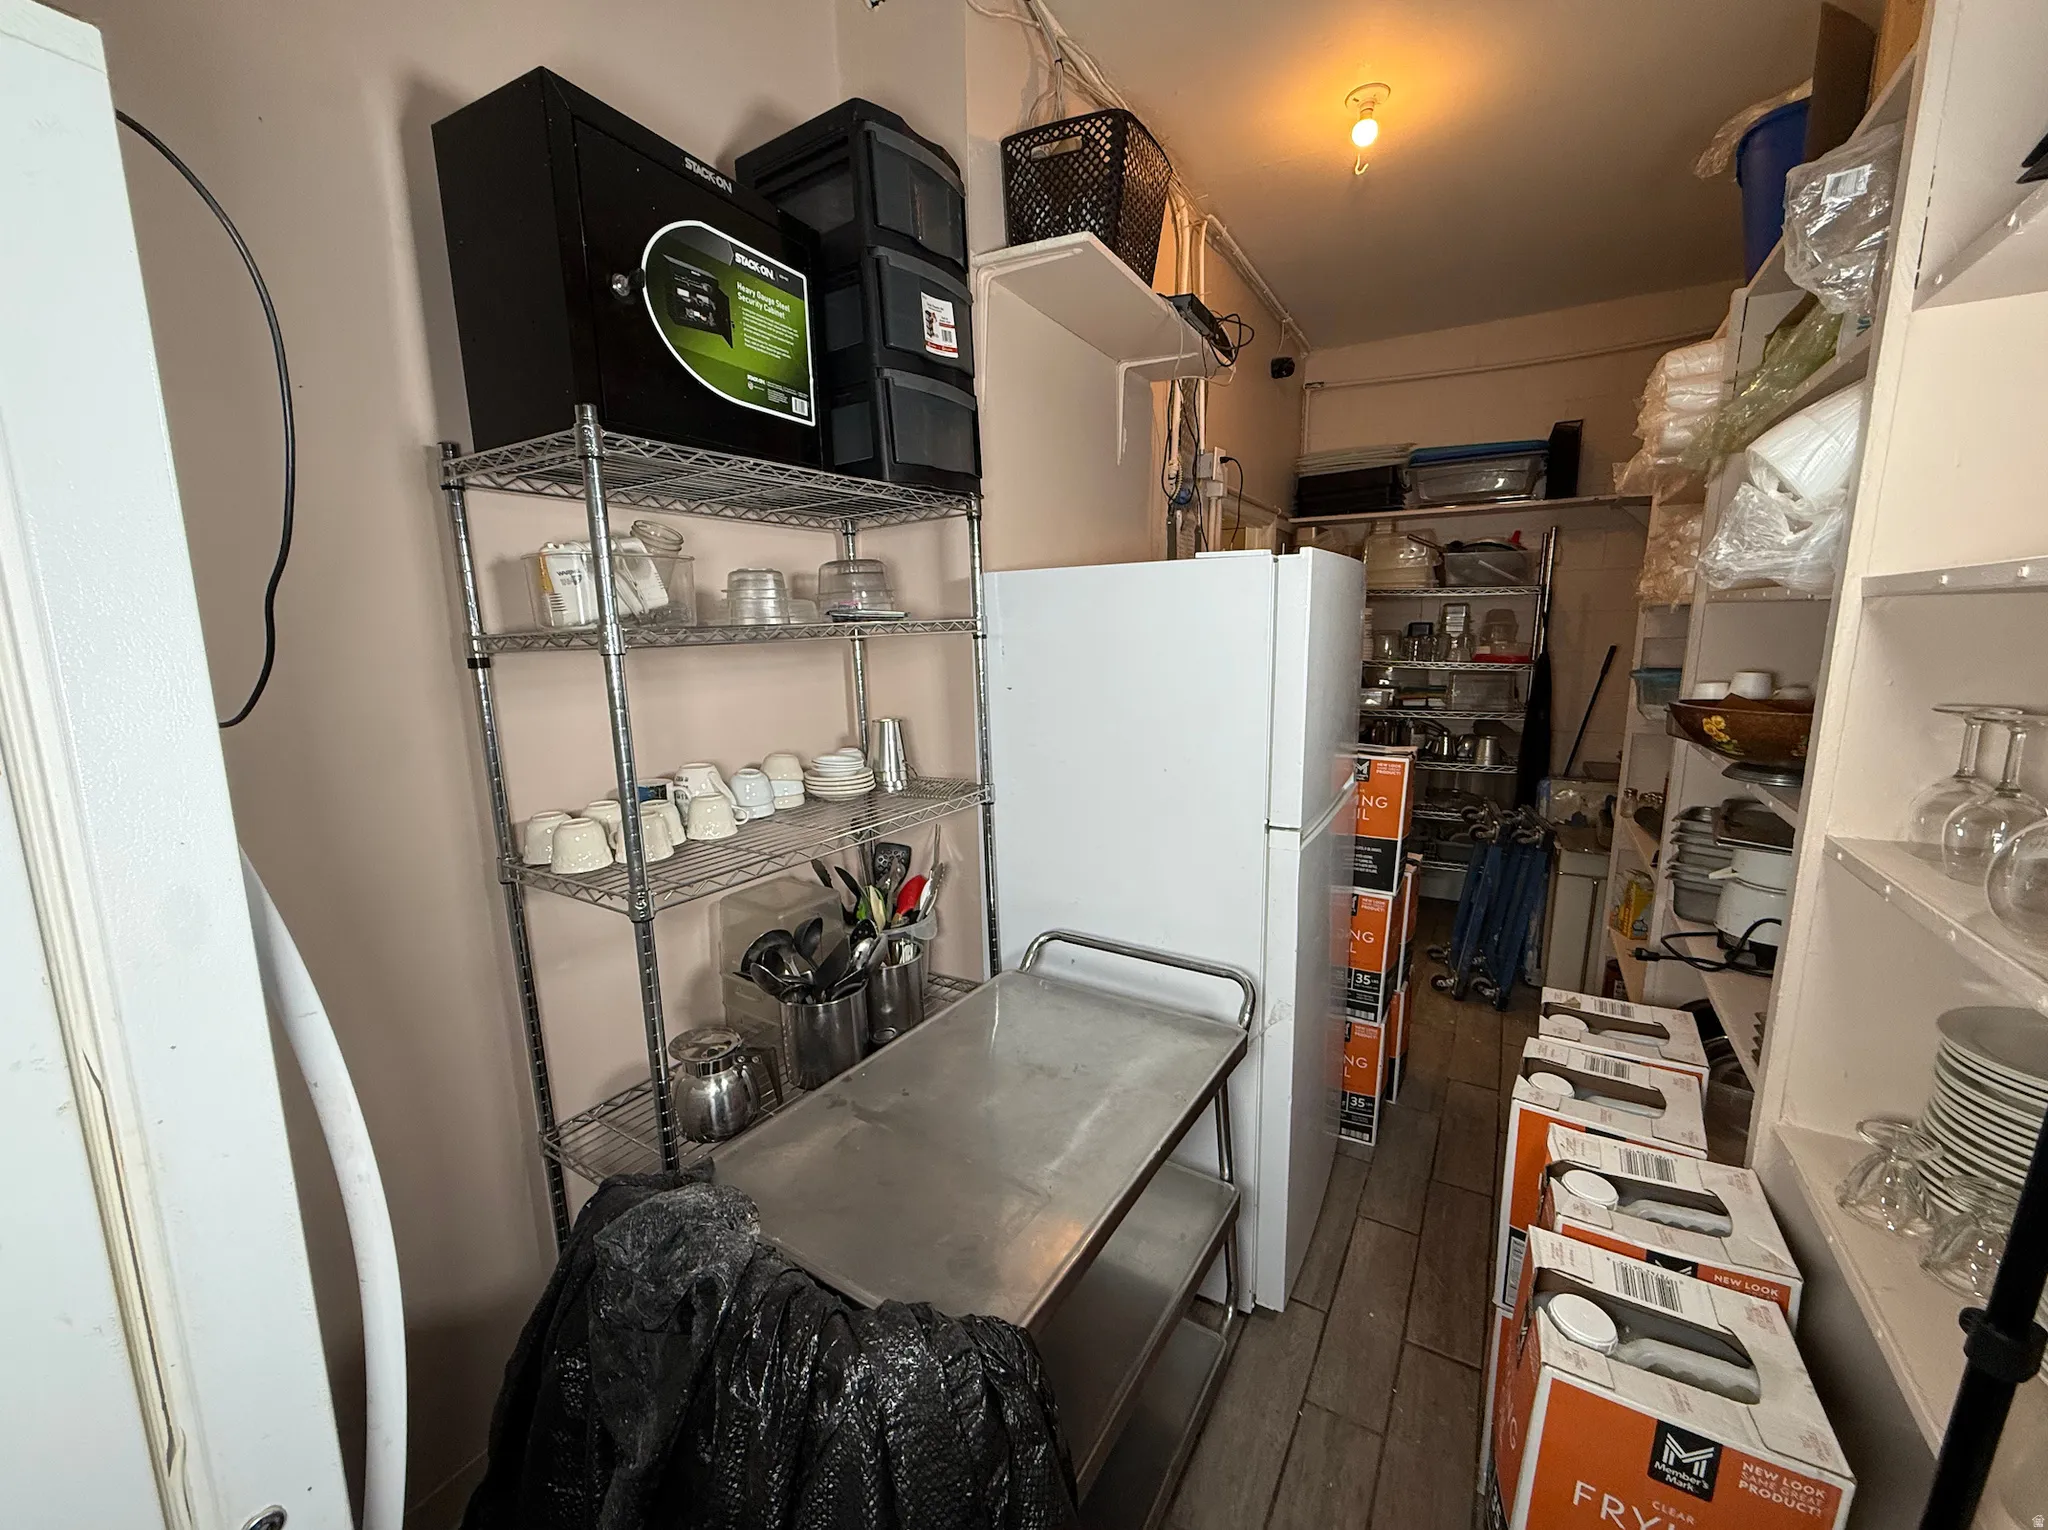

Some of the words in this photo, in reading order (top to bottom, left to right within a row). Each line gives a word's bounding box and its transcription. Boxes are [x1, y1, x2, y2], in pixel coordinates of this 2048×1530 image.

[684, 156, 733, 194] STACK-ON
[734, 252, 775, 281] STACK-ON
[736, 281, 756, 298] Heavy
[756, 290, 775, 306] Gauge
[775, 299, 790, 312] Steel
[737, 291, 763, 310] Security
[763, 303, 785, 319] Cabinet
[1360, 795, 1388, 809] NG
[1349, 930, 1375, 944] NG
[1355, 973, 1371, 985] 35
[1343, 1055, 1369, 1069] NG
[1349, 1096, 1366, 1108] 35
[1713, 1274, 1743, 1287] NEW
[1743, 1282, 1780, 1297] LOOK
[1653, 1460, 1710, 1490] Member's
[1740, 1470, 1777, 1491] SAME
[1779, 1485, 1826, 1508] GREAT
[1742, 1460, 1779, 1481] NEW
[1781, 1476, 1827, 1500] LOOK
[1572, 1479, 1676, 1530] FRY
[1651, 1500, 1696, 1526] CLEAR
[1738, 1479, 1823, 1519] PRODUCT!
